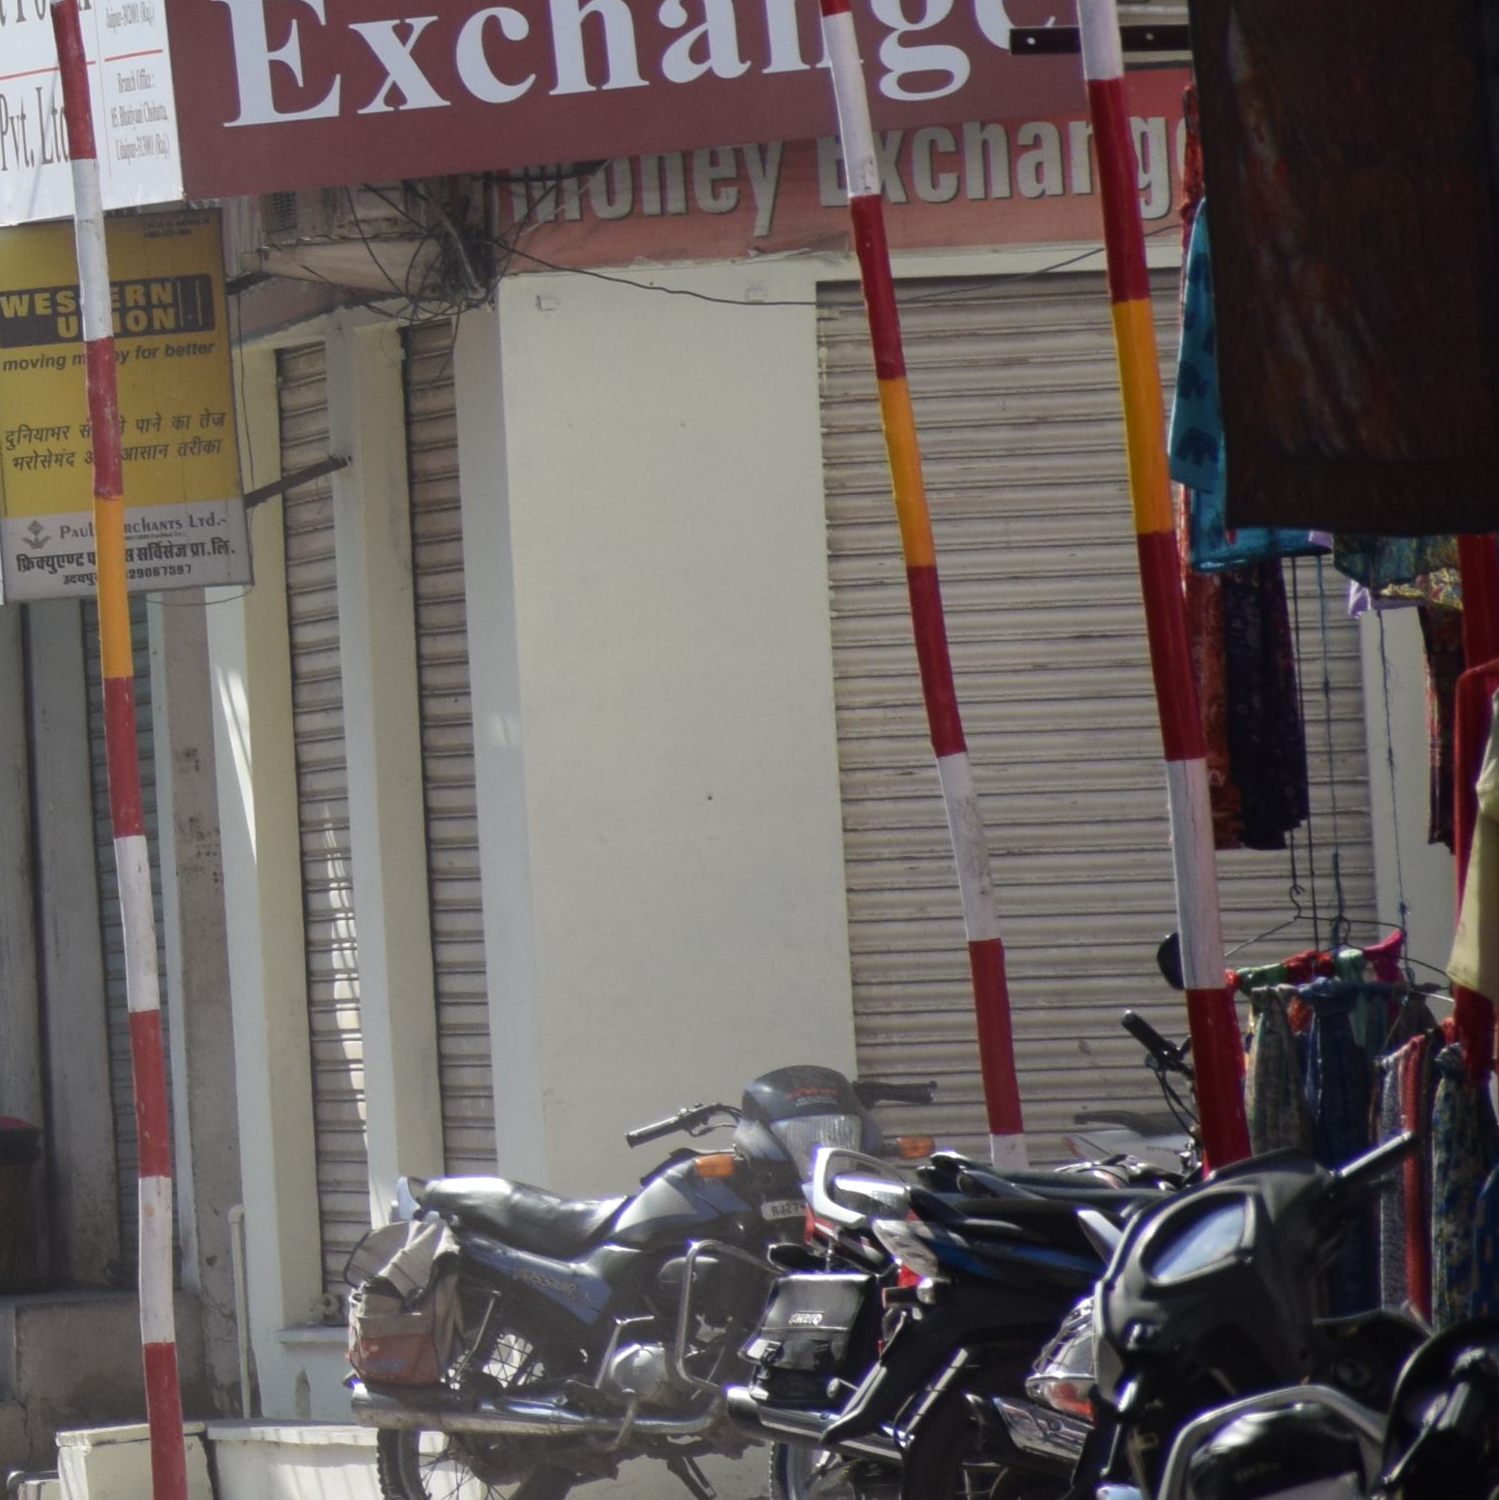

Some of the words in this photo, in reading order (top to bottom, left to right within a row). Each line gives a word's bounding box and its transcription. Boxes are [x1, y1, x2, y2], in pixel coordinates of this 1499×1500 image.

[818, 115, 1186, 221] Exchang
[0, 281, 175, 319] WESERN
[58, 307, 177, 339] UION
[3, 354, 66, 371] moving
[72, 349, 129, 366] mey
[135, 344, 159, 360] for
[165, 341, 216, 357] better
[5, 423, 70, 450] दुनियाभर
[172, 414, 190, 430] का
[177, 437, 223, 457] तरीका
